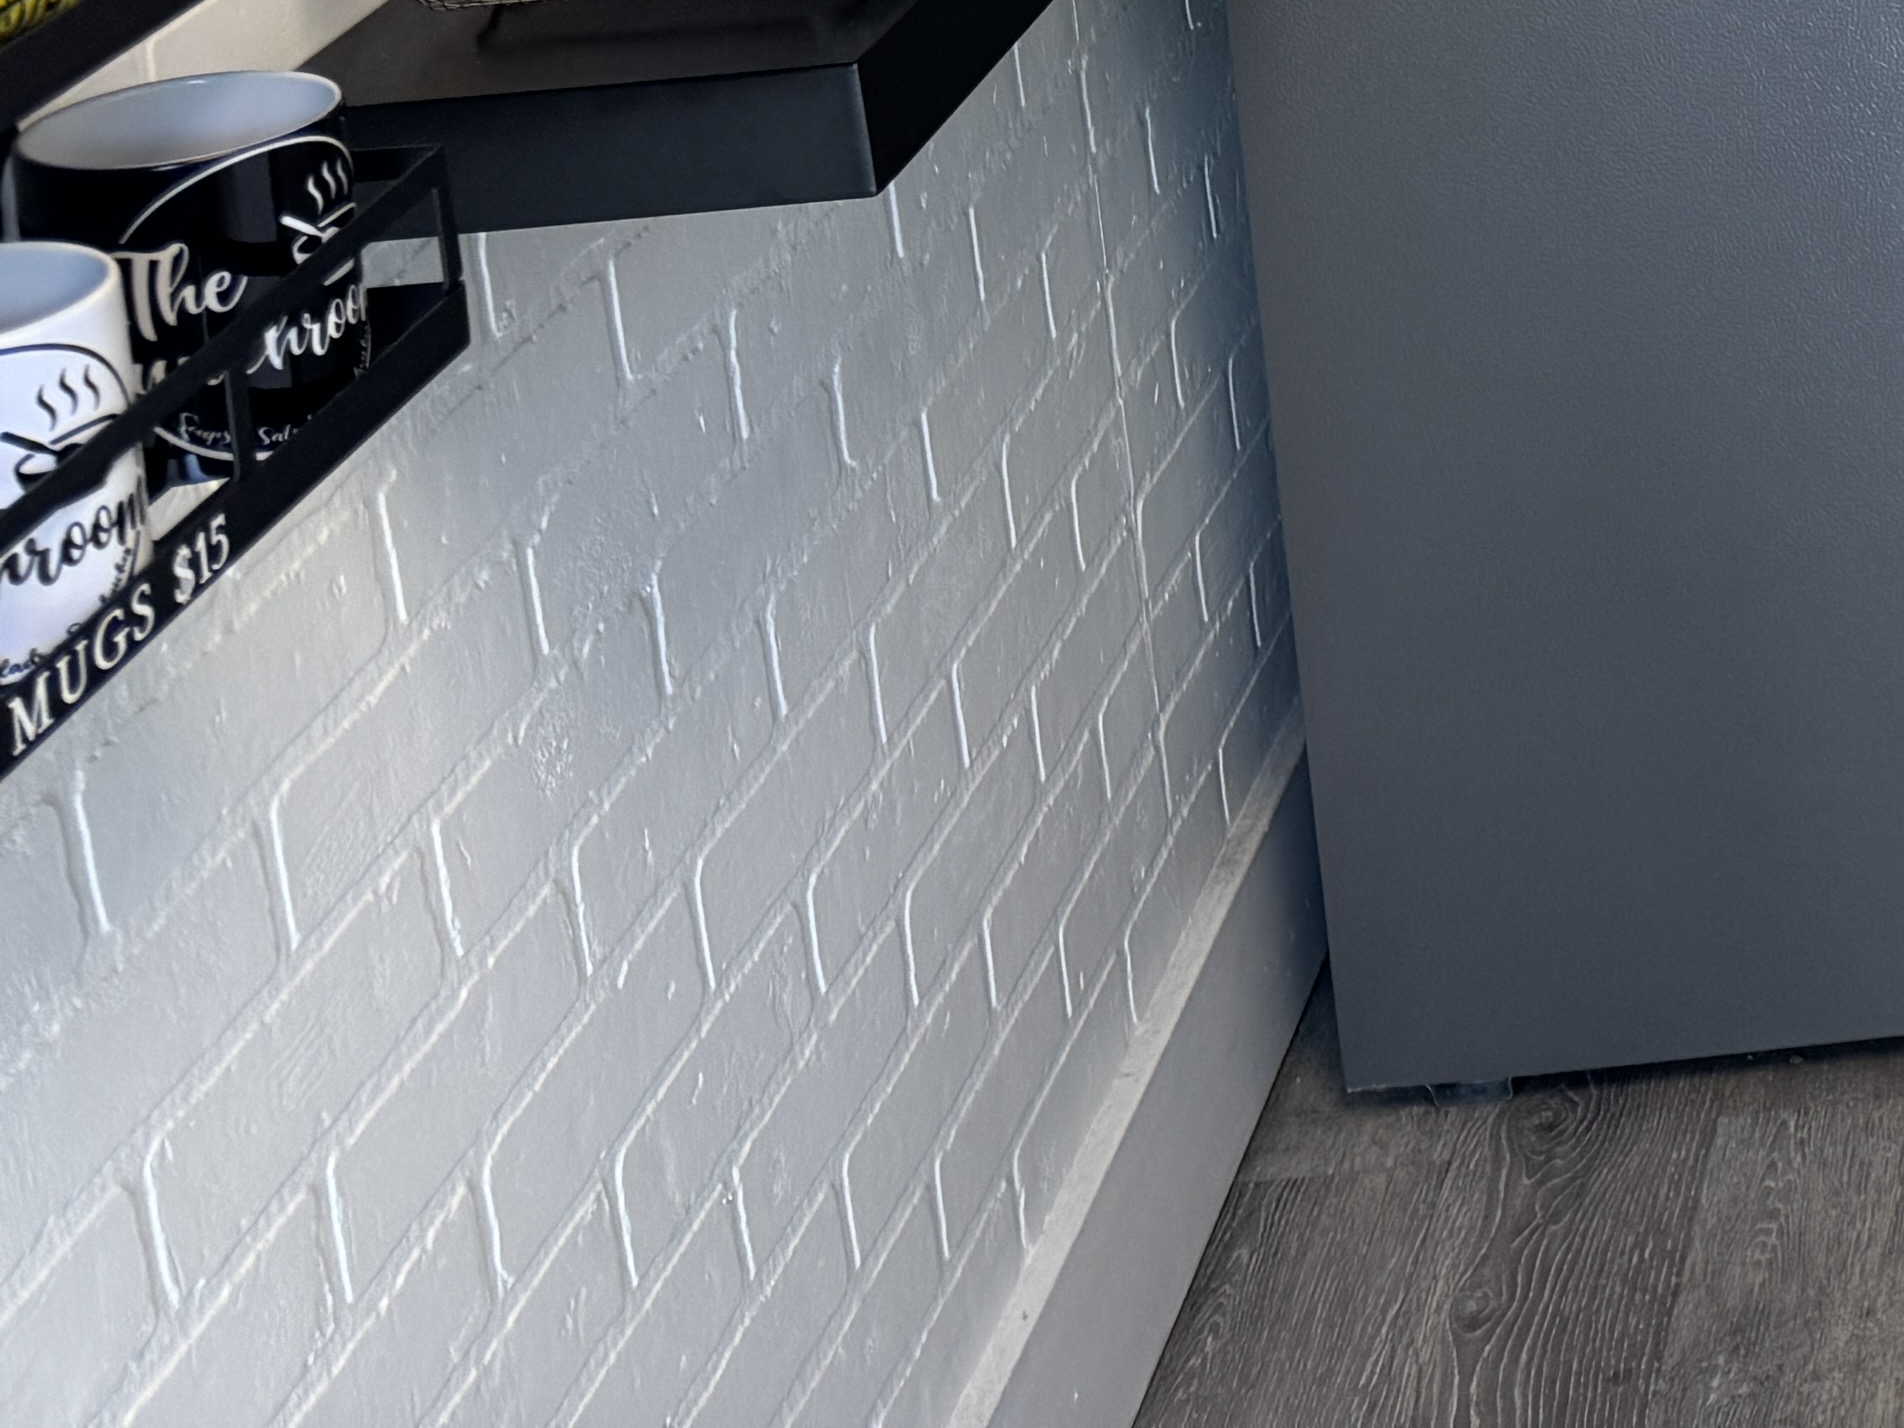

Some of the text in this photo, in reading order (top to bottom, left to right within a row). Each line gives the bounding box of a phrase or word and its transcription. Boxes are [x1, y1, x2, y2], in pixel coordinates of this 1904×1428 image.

[112, 242, 248, 342] The
[8, 583, 156, 757] MUGS
[173, 512, 230, 605] $15
